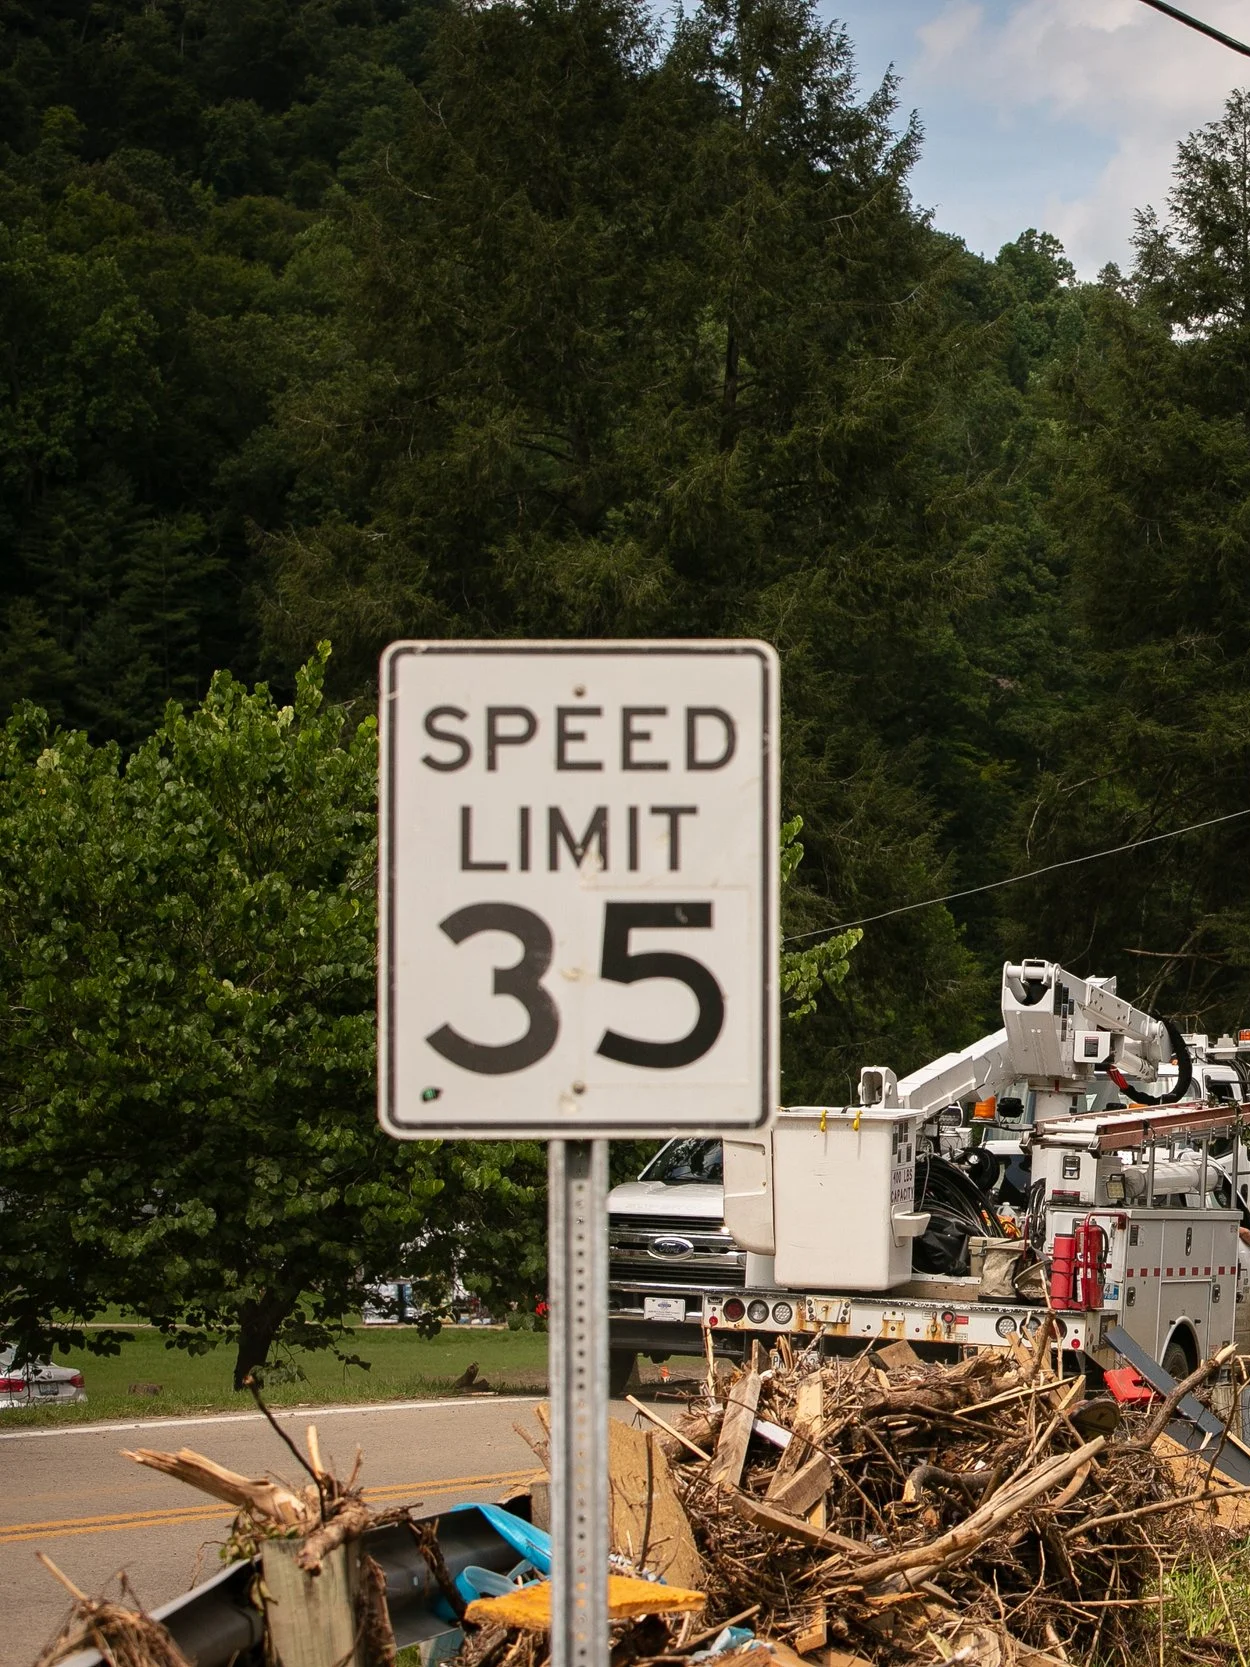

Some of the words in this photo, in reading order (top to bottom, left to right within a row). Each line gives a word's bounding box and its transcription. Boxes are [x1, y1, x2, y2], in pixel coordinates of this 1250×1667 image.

[422, 705, 737, 772] SPEED
[459, 805, 699, 873] LIMIT
[424, 901, 726, 1076] 35
[904, 1168, 912, 1182] LBS
